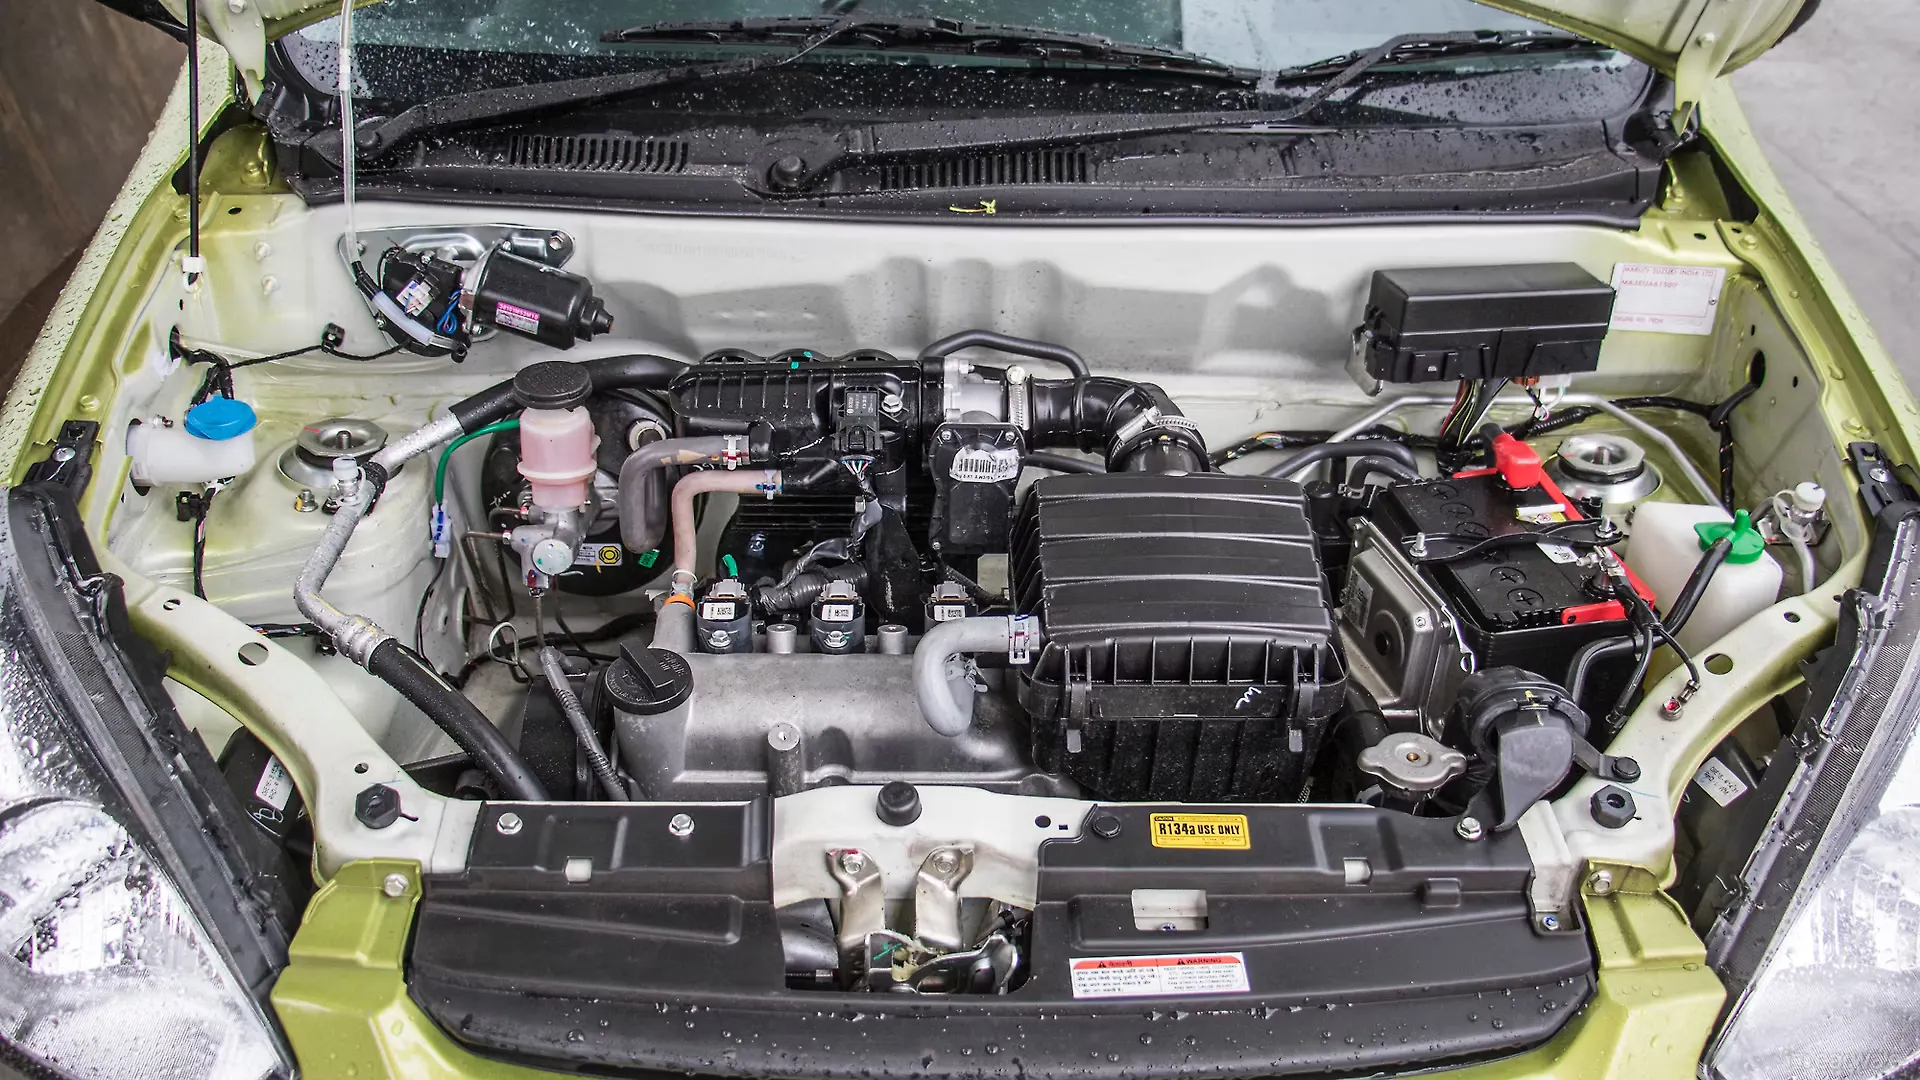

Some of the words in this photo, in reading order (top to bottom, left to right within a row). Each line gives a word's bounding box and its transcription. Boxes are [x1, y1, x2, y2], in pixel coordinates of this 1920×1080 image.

[1159, 822, 1196, 835] R134a
[1197, 824, 1215, 835] USE
[1218, 824, 1240, 835] ONLY
